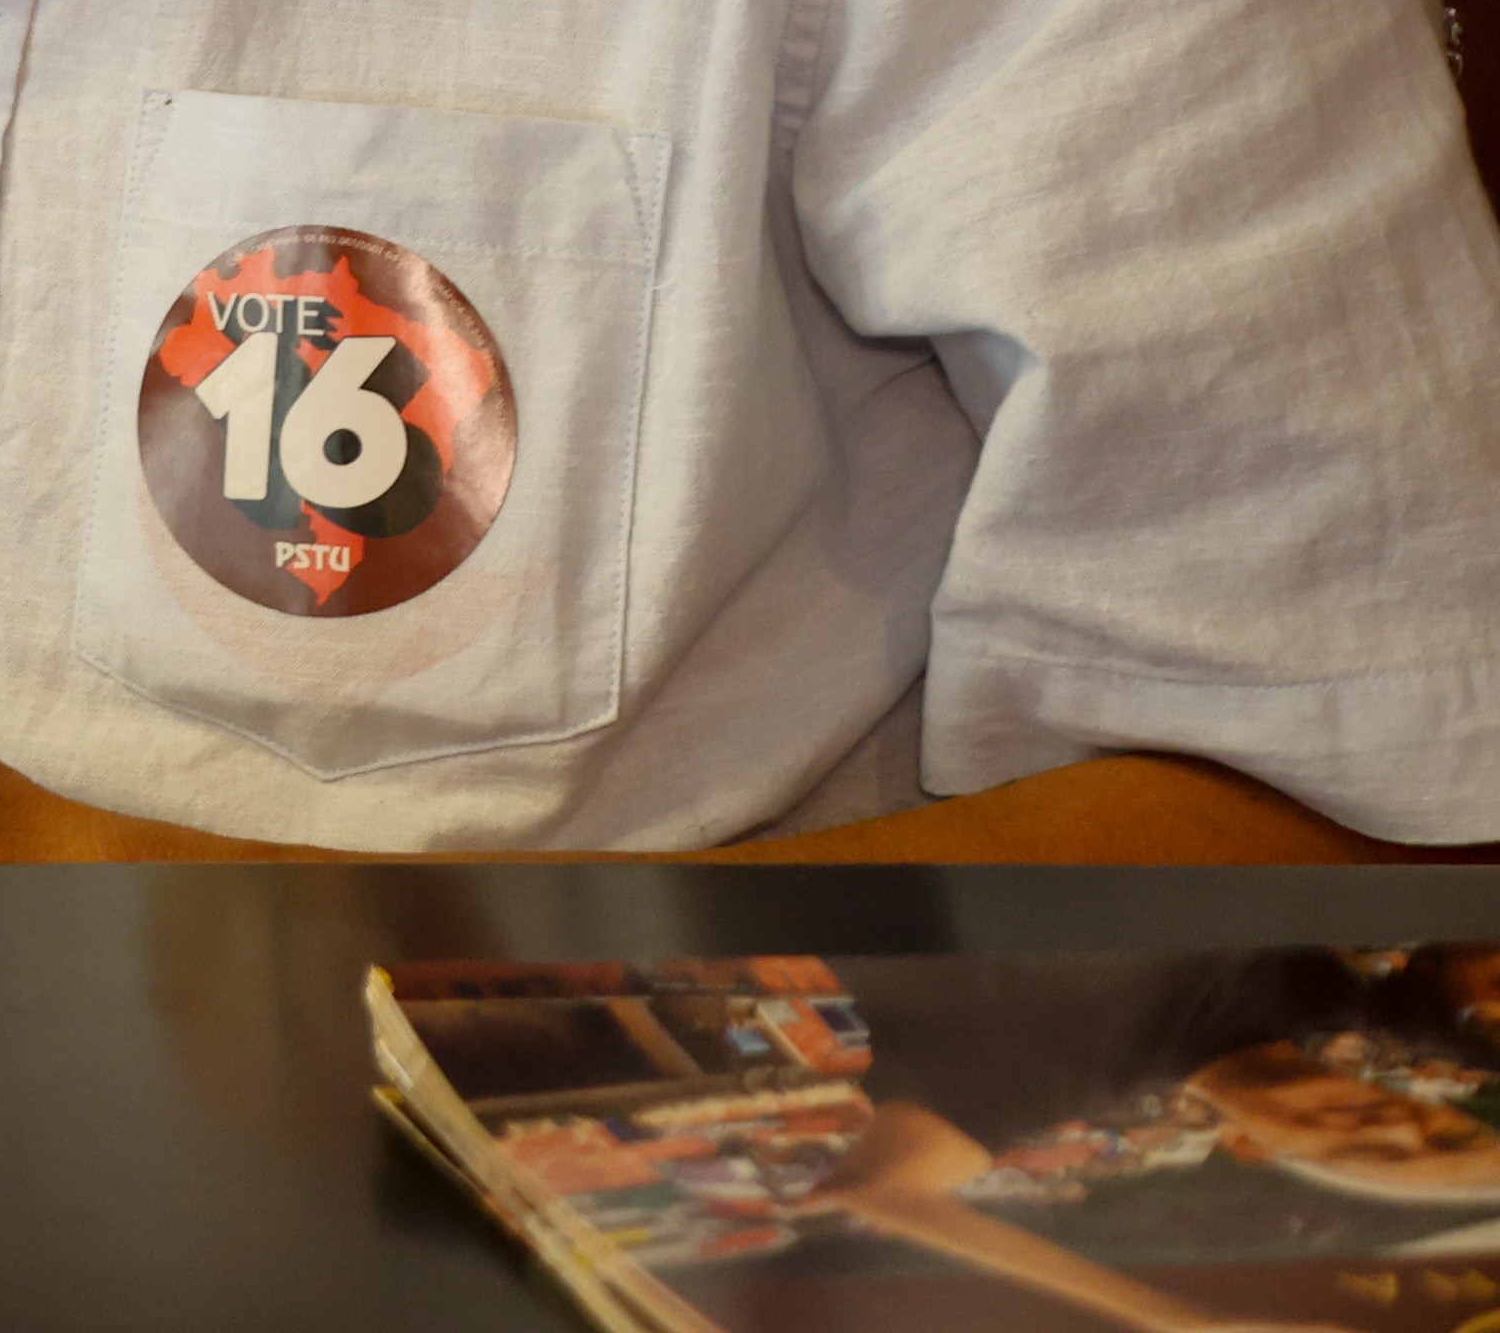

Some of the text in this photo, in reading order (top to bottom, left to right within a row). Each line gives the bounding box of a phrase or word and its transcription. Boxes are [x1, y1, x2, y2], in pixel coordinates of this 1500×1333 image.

[206, 291, 326, 336] VOTE
[195, 332, 408, 509] 16
[275, 541, 351, 573] PSTU
